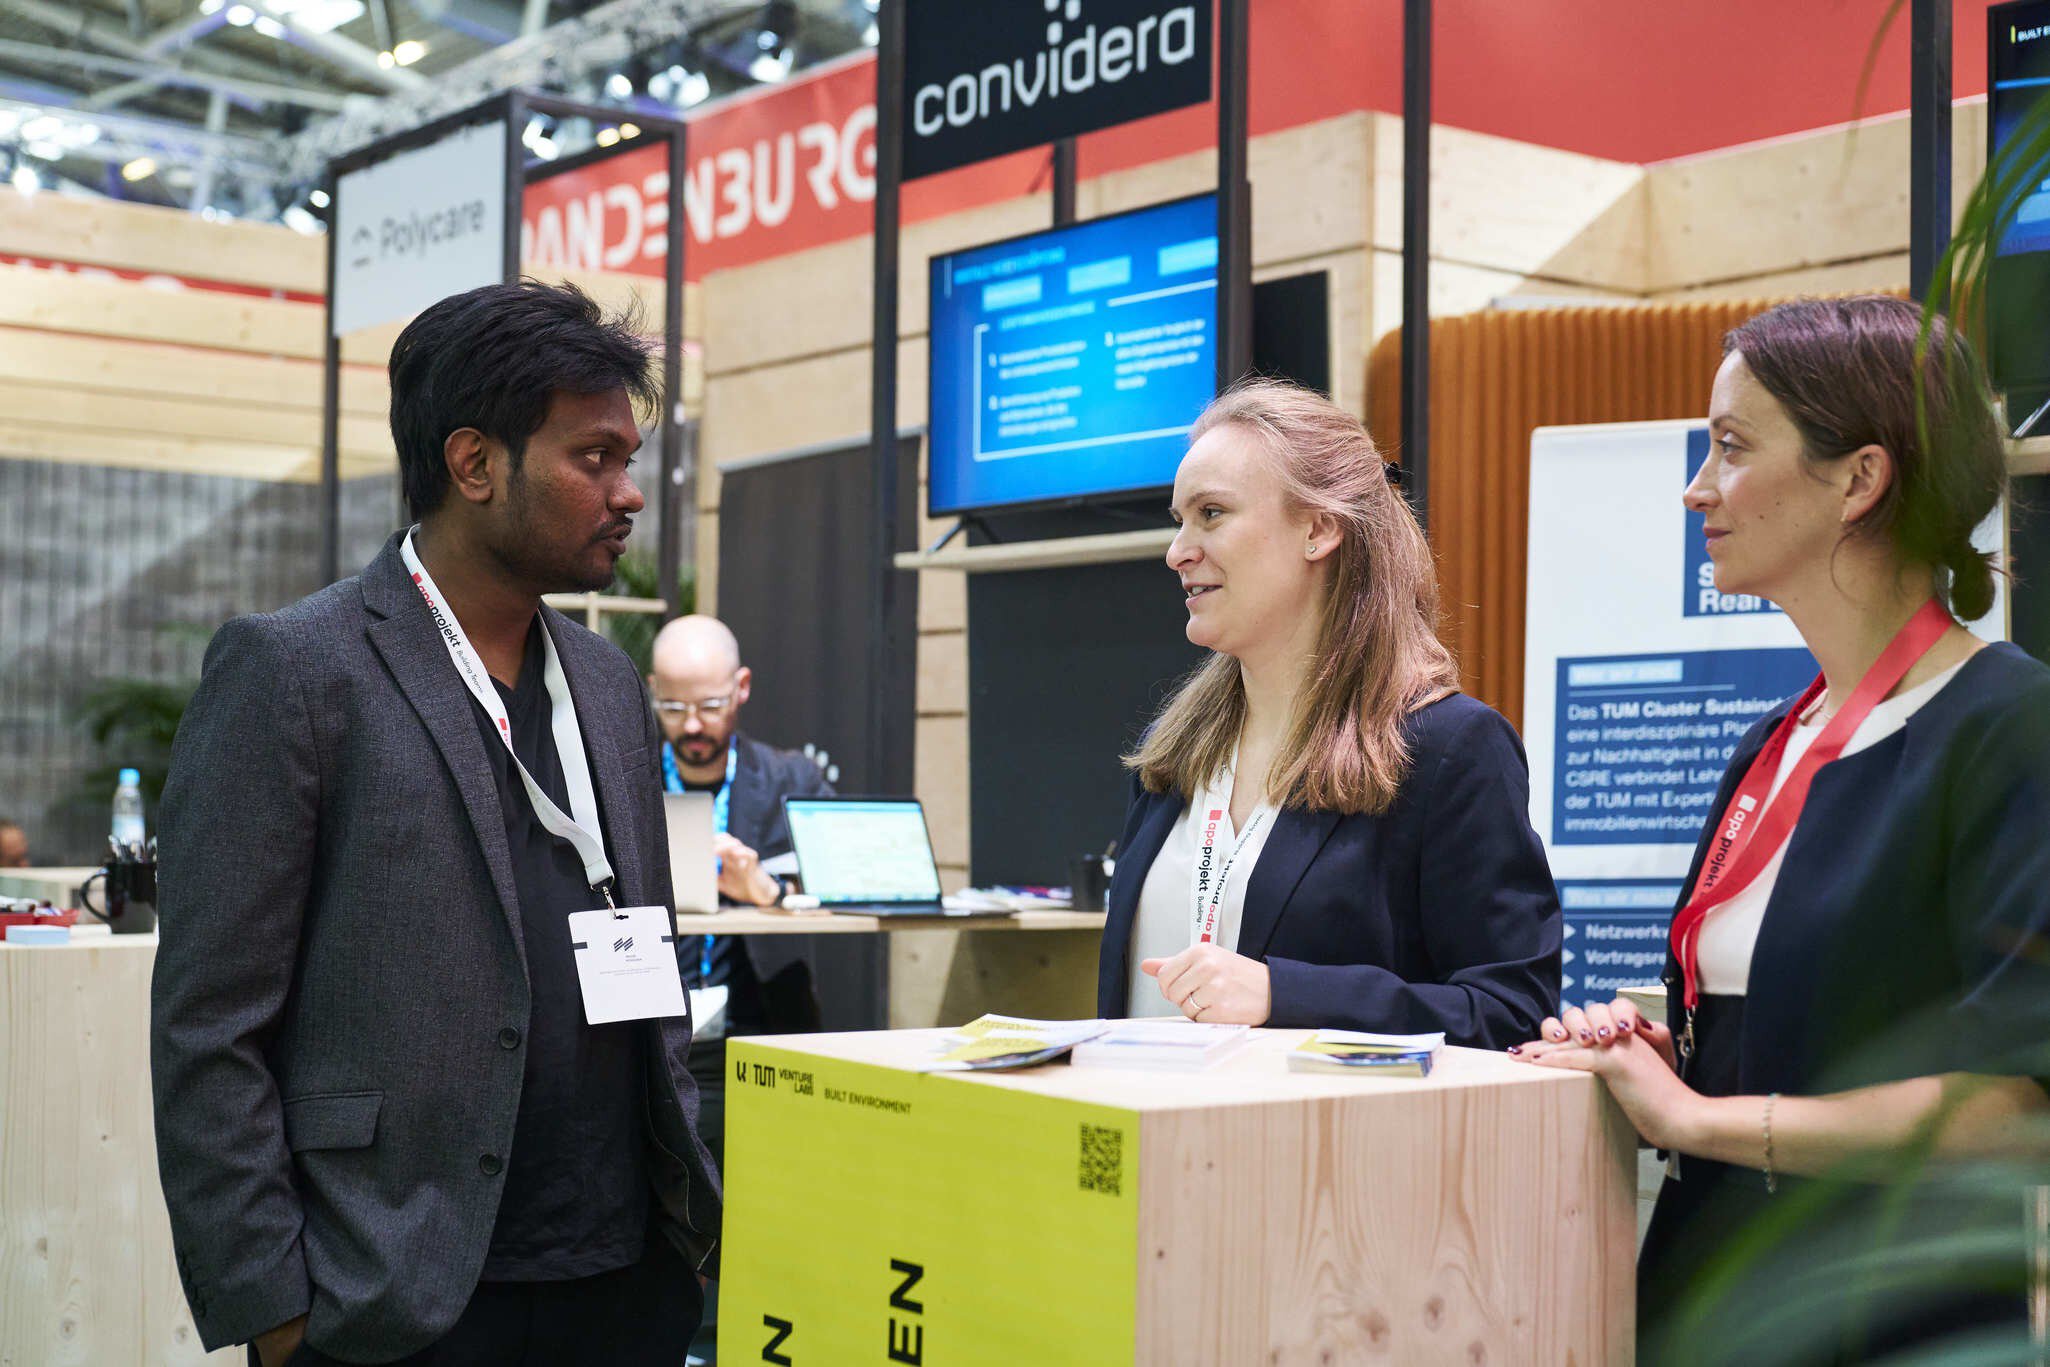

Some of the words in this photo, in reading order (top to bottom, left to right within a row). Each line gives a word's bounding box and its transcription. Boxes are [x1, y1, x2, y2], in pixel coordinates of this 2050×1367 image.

[912, 6, 1196, 136] convidera
[520, 105, 876, 272] ANDENBURG
[380, 198, 485, 259] Polycare
[1567, 704, 1598, 721] Das
[1601, 701, 1639, 719] TUM
[1643, 699, 1702, 718] Cluster
[1567, 727, 1600, 743] eine
[1566, 752, 1591, 766] zur
[1593, 748, 1700, 766] Nachhaltigkeit
[1704, 747, 1719, 760] in
[1565, 770, 1612, 787] CSRE
[1613, 768, 1684, 786] verbindet
[1564, 794, 1591, 810] der
[1595, 792, 1632, 808] TUM
[1633, 792, 1659, 807] mit
[1198, 822, 1217, 892] apoprojekt
[1703, 810, 1747, 888] apoprojekt
[1205, 858, 1234, 932] apoprojekt
[753, 1063, 776, 1088] TUM
[779, 1068, 814, 1083] VENTURE
[794, 1082, 814, 1096] LABS
[824, 1087, 847, 1102] BUILT
[849, 1091, 912, 1115] ENVIRONMENT
